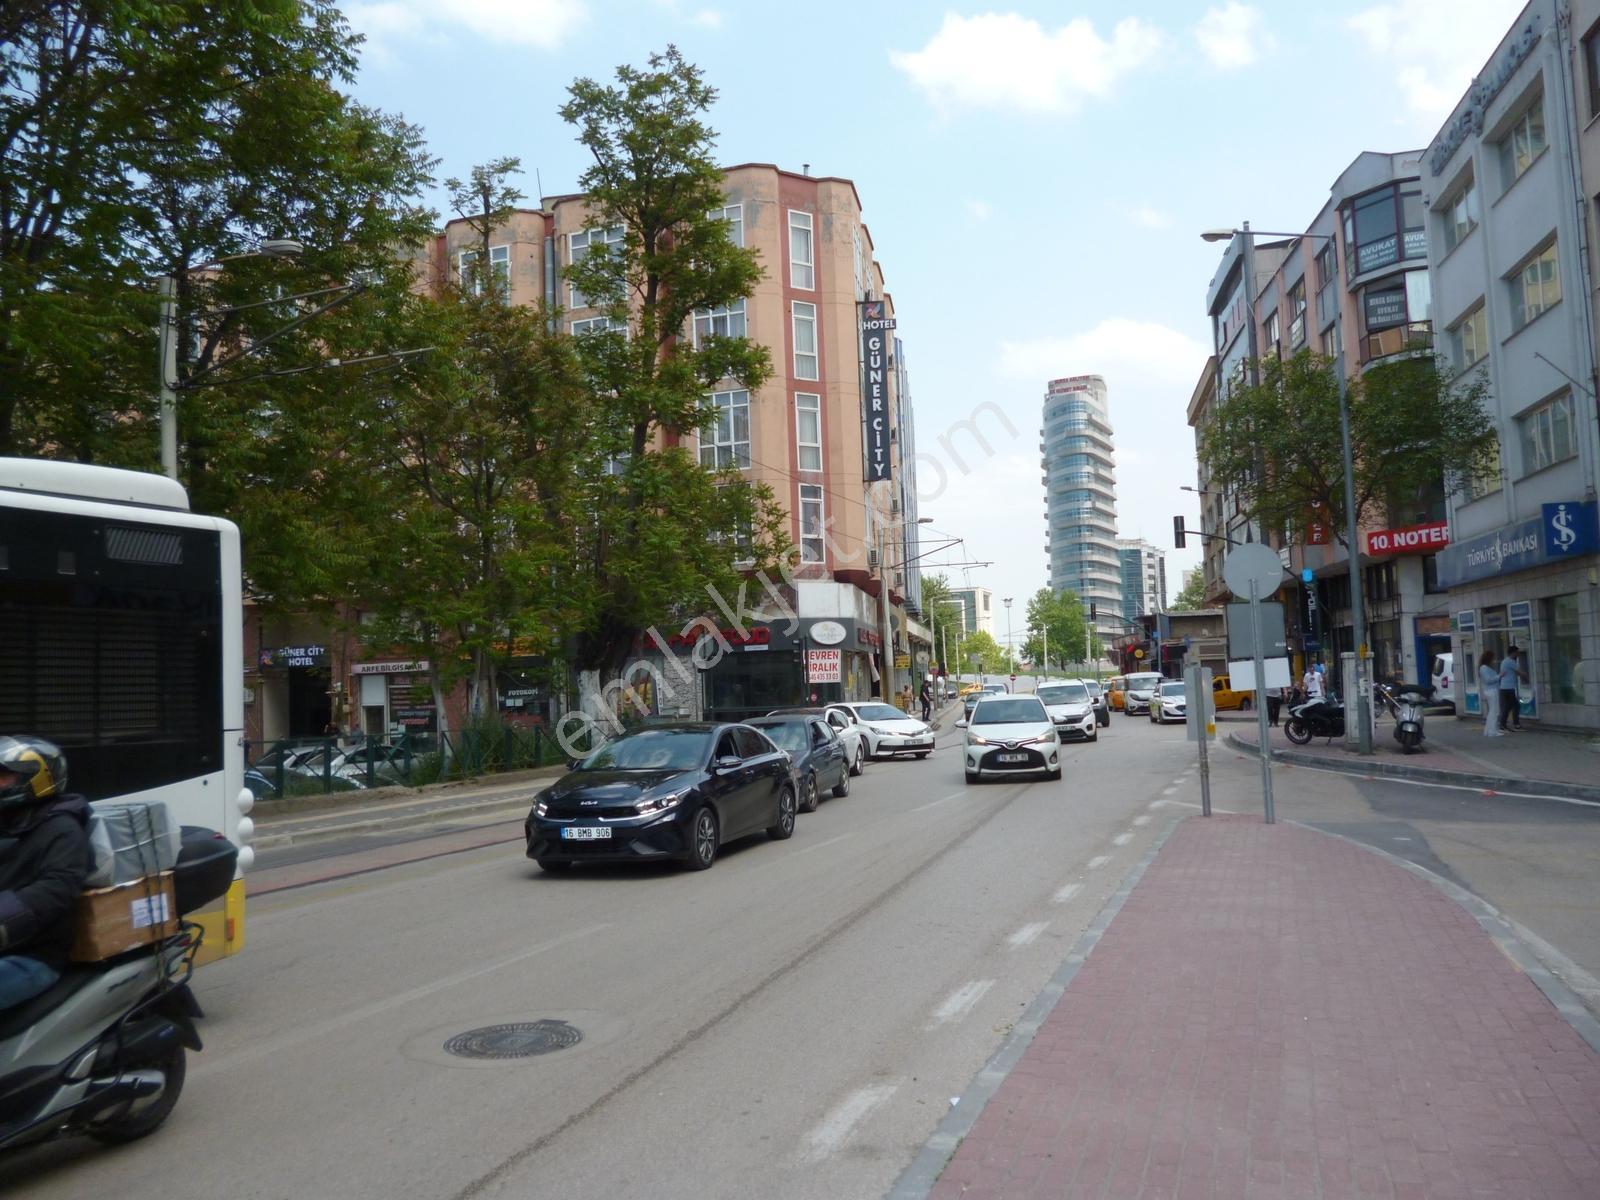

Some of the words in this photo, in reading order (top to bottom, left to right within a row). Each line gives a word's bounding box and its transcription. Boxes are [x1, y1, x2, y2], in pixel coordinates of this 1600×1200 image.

[1405, 233, 1425, 242] AVUK
[1360, 238, 1397, 257] AVUKAT
[863, 319, 896, 331] HOTEL
[868, 337, 883, 412] GÜNER
[1370, 535, 1391, 550] 10.
[1467, 544, 1496, 567] TÜRKİYE
[1503, 534, 1538, 557] BANKASI
[279, 646, 305, 657] GÜNER
[809, 650, 839, 660] EVREN
[288, 656, 314, 667] HOTEL
[809, 661, 838, 672] İRALIK
[565, 828, 574, 838] 16
[577, 828, 592, 838] BMB
[596, 828, 611, 838] 906
